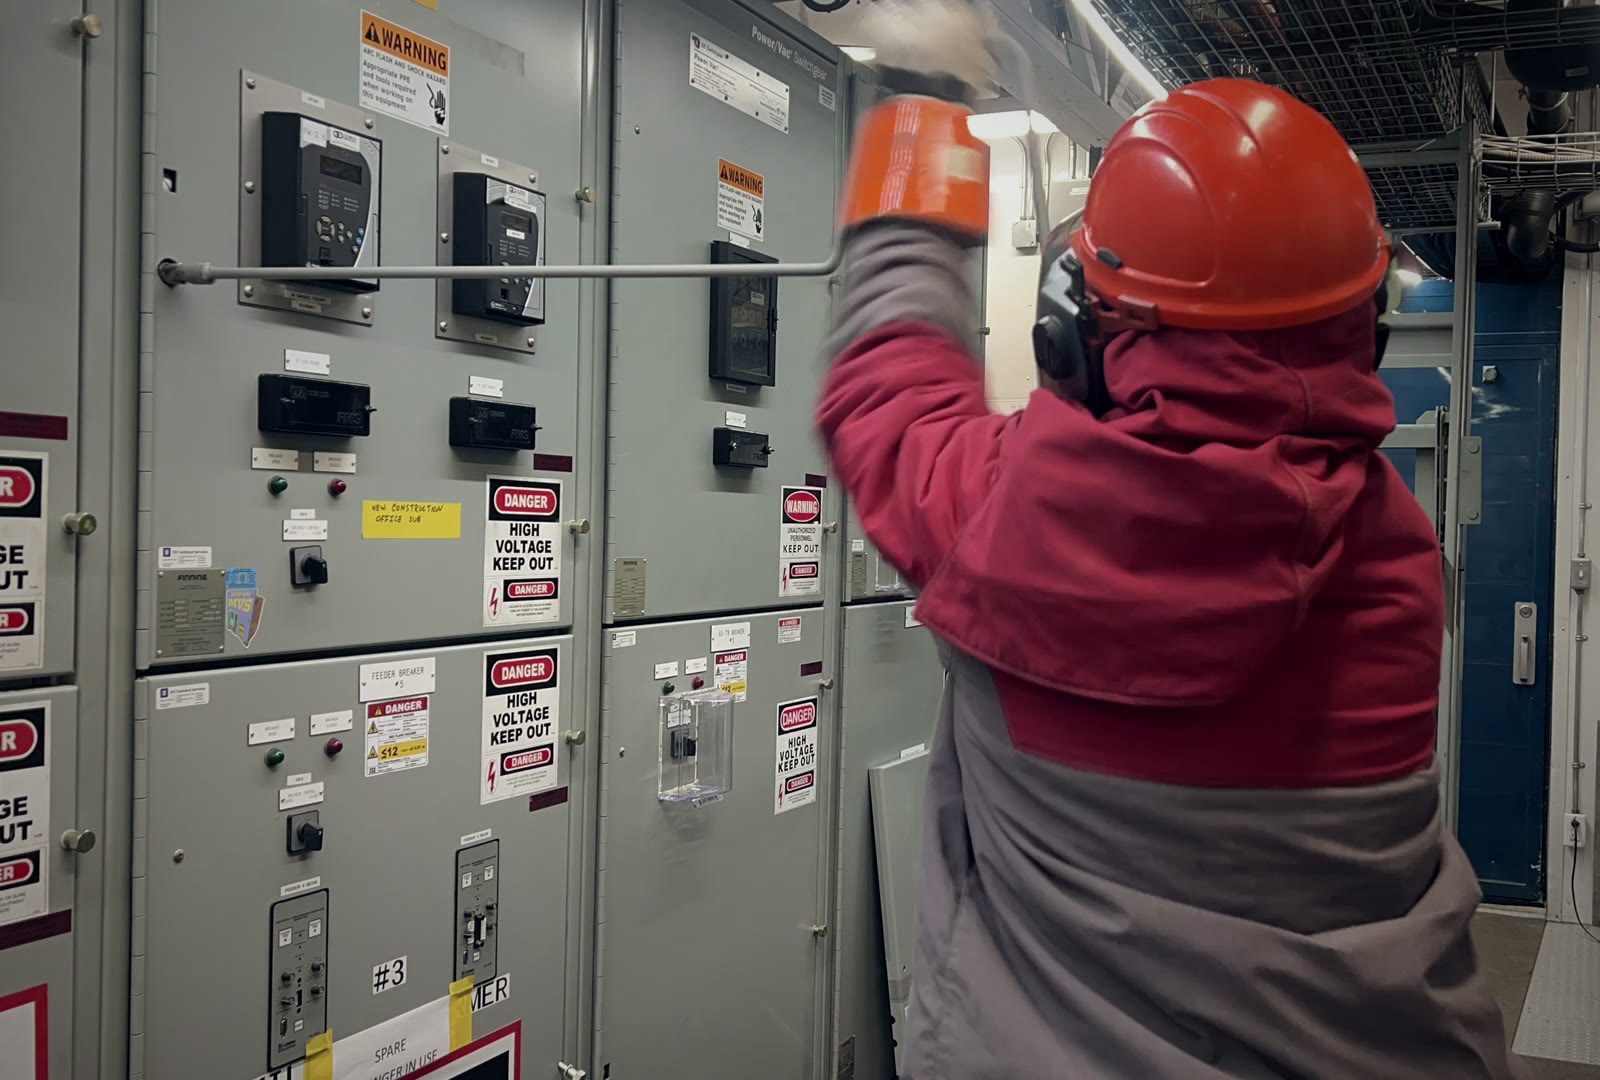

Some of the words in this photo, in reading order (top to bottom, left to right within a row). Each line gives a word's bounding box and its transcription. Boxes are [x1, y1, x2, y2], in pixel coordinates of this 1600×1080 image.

[382, 27, 447, 71] WARNING
[363, 47, 375, 57] ARC
[376, 52, 393, 63] FLASH
[394, 58, 406, 69] AND
[407, 64, 424, 77] SHOCK
[426, 72, 446, 85] HAZARD
[363, 60, 398, 78] Appropriate
[399, 75, 410, 84] PPE
[794, 53, 828, 81] Switchgear
[363, 71, 374, 80] and
[375, 74, 391, 86] tools
[392, 82, 416, 95] required
[363, 81, 379, 90] when
[381, 87, 404, 102] working
[406, 96, 413, 104] on
[363, 90, 374, 99] this
[729, 168, 763, 194] WARNING
[371, 503, 387, 512] NEW
[391, 503, 444, 513] CONSTRUCTION
[504, 493, 548, 509] DANGER
[786, 499, 818, 514] WARNING
[375, 515, 402, 523] OFFICE
[409, 515, 421, 523] SUB
[509, 523, 540, 536] HIGH
[495, 540, 552, 554] VOLTAGE
[783, 544, 802, 553] KEEP
[803, 544, 819, 553] OUT
[493, 557, 525, 570] KEEP
[529, 557, 554, 570] OUT
[514, 584, 548, 595] DANGER
[724, 653, 744, 663] DANGER
[371, 670, 396, 681] FEEDER
[399, 666, 424, 678] BREAKER
[501, 662, 545, 681] DANGER
[385, 700, 422, 715] DANGER
[507, 692, 537, 708] HIGH
[493, 706, 549, 728] VOLTAGE
[782, 706, 813, 726] DANGER
[490, 728, 523, 746] KEEP
[527, 723, 551, 739] OUT
[788, 734, 807, 748] HIGH
[511, 751, 543, 767] DANGER
[779, 743, 814, 762] VOLTAGE
[778, 757, 799, 774] KEEP
[800, 753, 815, 767] OUT
[791, 776, 809, 788] DANGER
[373, 959, 404, 992] #3
[374, 1038, 407, 1064] SPARE
[405, 1059, 417, 1073] IN
